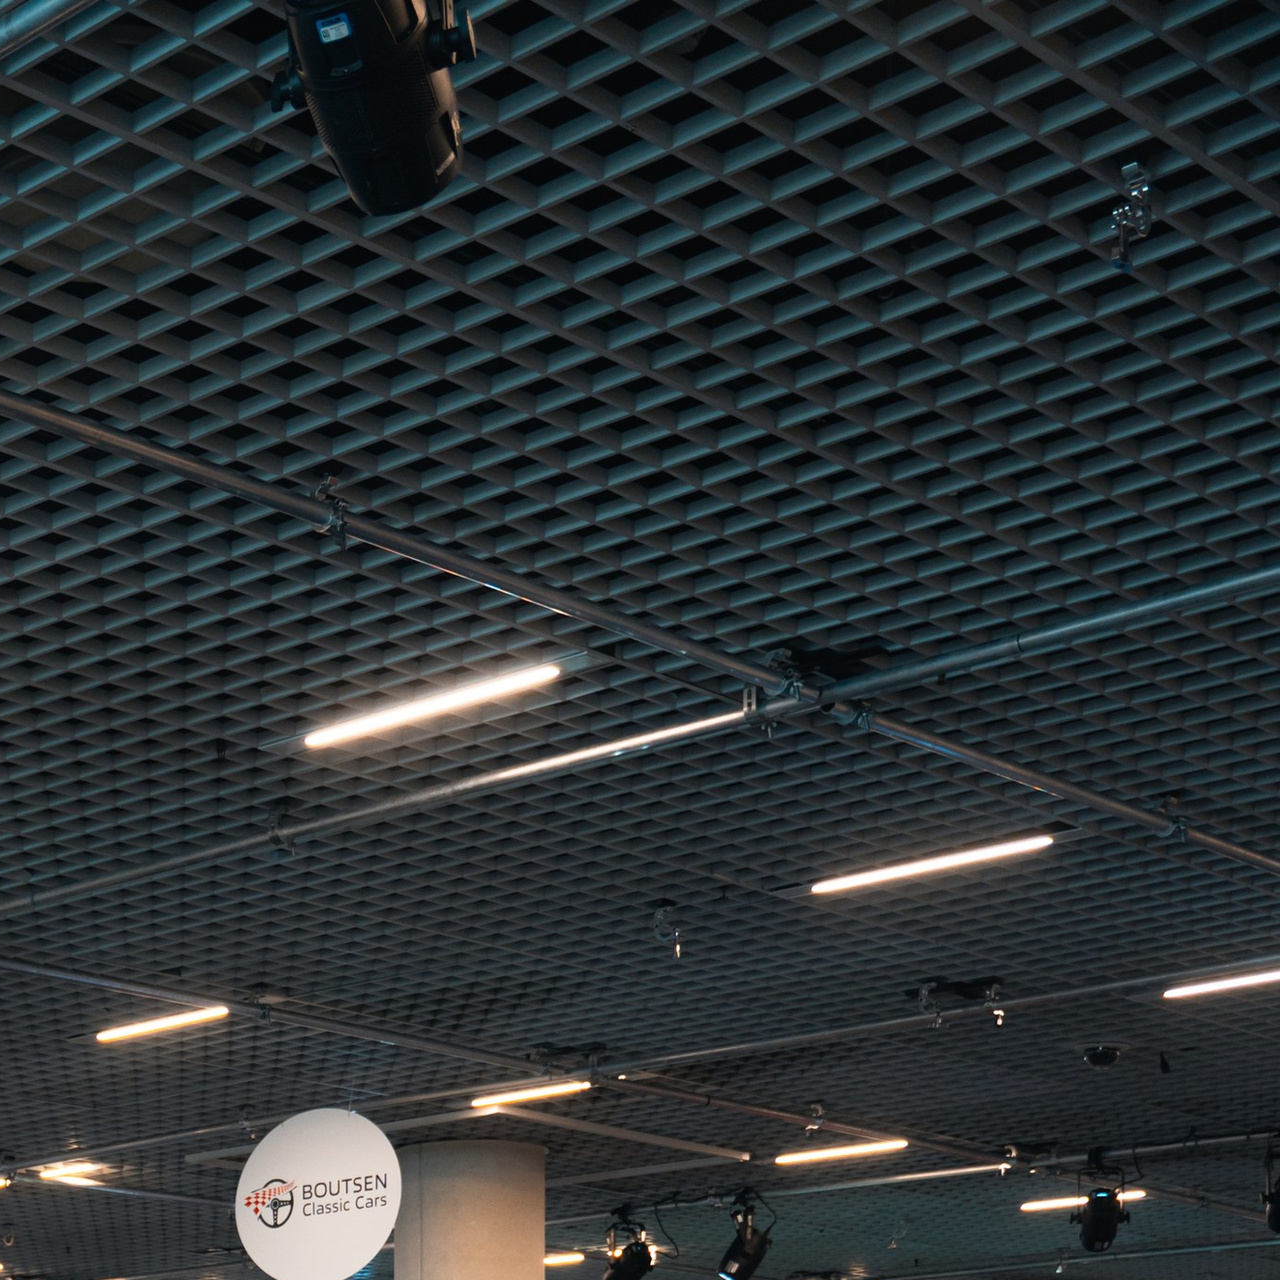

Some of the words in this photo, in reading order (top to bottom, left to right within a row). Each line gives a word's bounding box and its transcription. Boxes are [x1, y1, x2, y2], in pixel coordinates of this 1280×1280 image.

[302, 1173, 388, 1200] BOUTSEN
[302, 1198, 351, 1217] Classic
[355, 1195, 388, 1210] Cars
